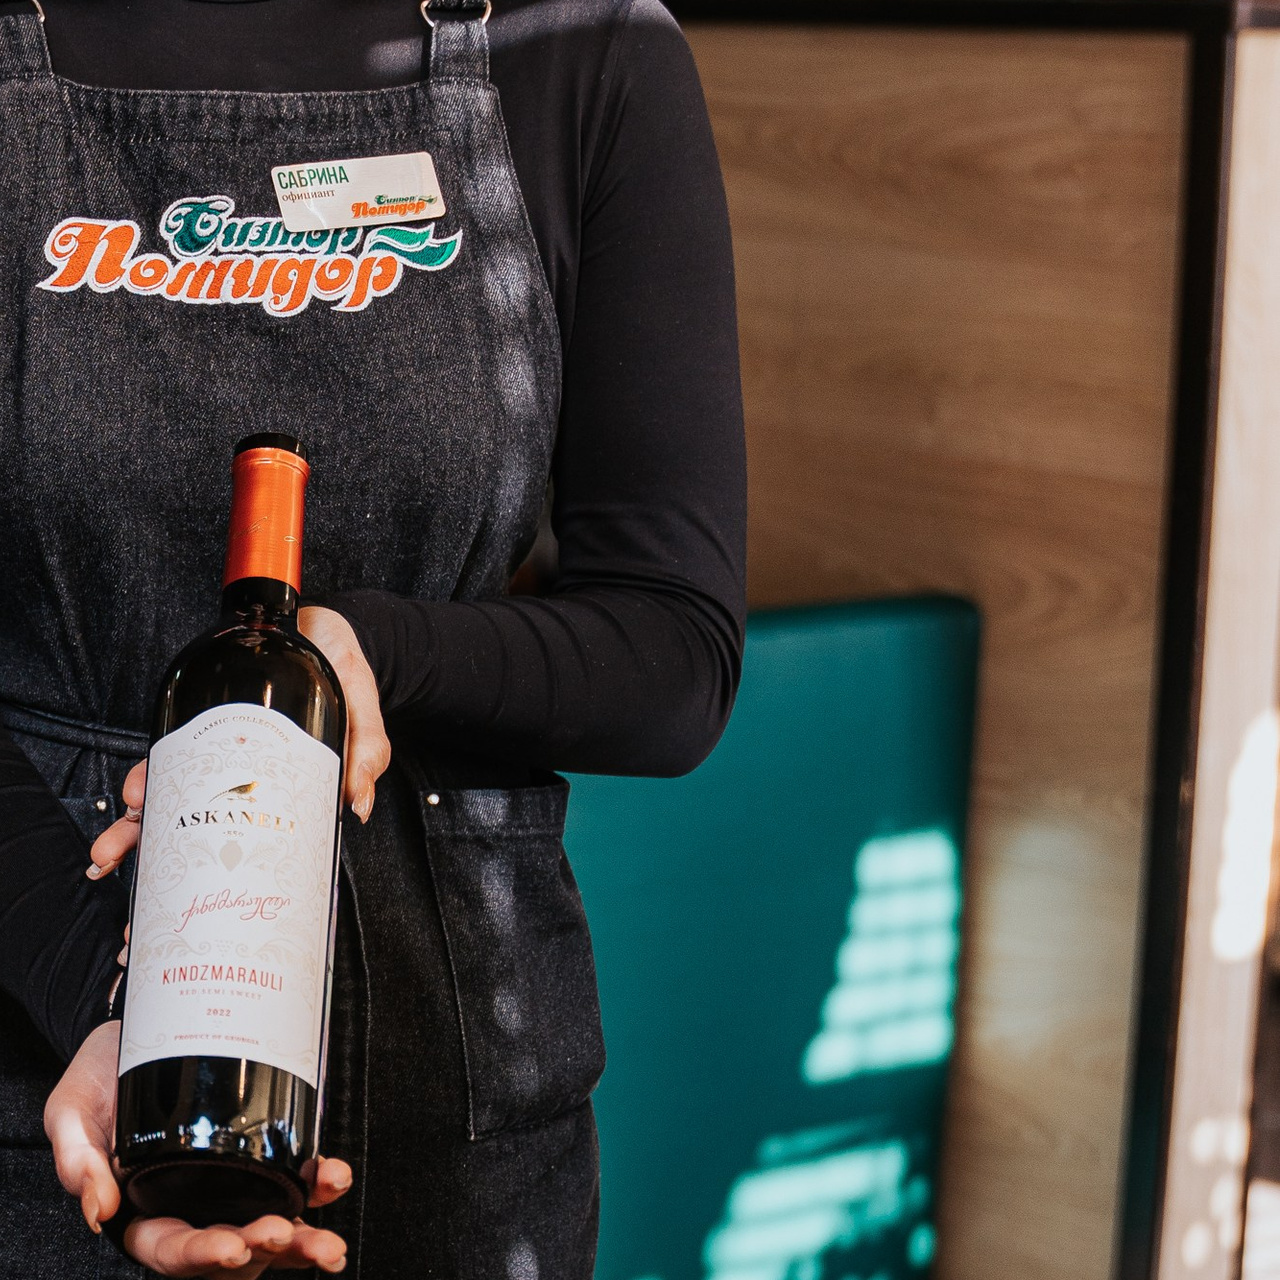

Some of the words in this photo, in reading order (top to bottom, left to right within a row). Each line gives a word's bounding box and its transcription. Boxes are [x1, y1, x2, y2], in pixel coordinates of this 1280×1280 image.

[277, 165, 350, 190] САБРИНА
[281, 189, 336, 204] официант
[350, 200, 426, 219] Помидор
[37, 218, 402, 317] Помидор
[193, 717, 229, 740] CLASSIC
[232, 716, 292, 744] COLLECTION
[175, 810, 296, 836] ASKANELI
[162, 964, 283, 992] KINDZMARAULI
[179, 988, 198, 997] RED
[206, 1007, 232, 1017] 2022
